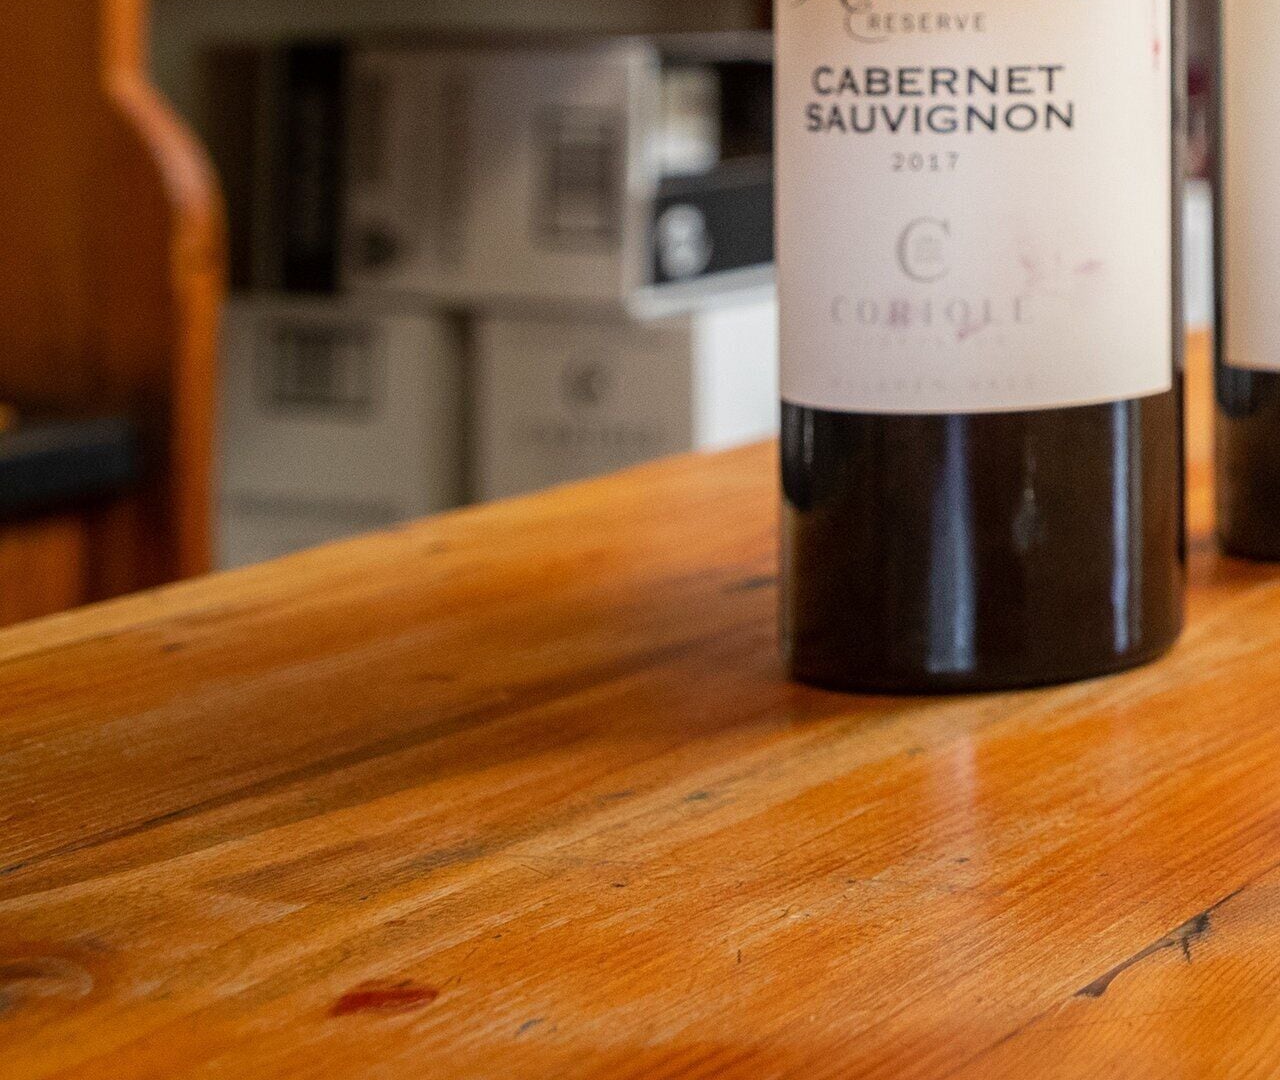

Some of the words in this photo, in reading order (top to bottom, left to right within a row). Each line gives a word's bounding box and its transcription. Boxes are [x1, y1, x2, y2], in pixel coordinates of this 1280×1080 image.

[868, 11, 986, 34] RESERVE
[812, 65, 1066, 97] CABERNET
[806, 100, 1076, 135] SAUVIGNON
[892, 150, 960, 172] 2017
